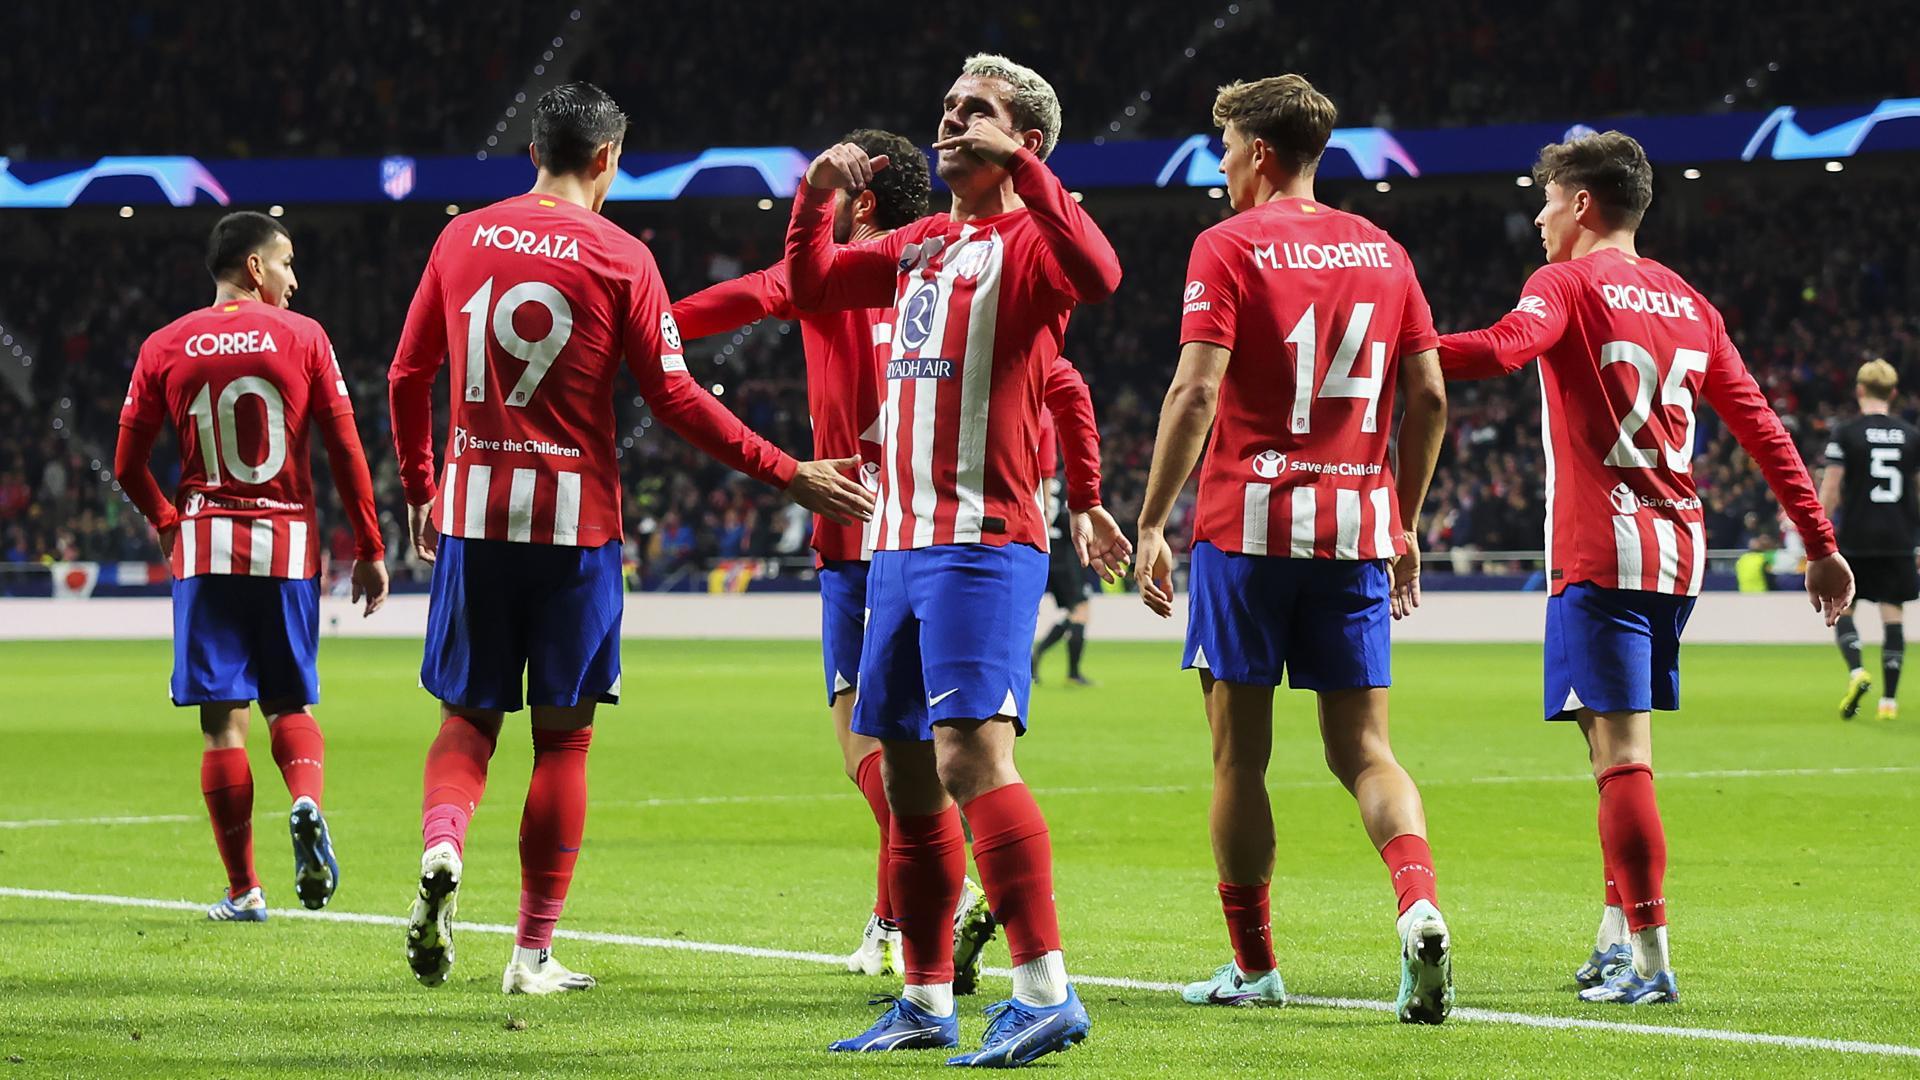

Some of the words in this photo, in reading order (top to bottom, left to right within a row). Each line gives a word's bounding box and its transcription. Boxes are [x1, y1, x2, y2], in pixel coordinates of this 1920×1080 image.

[472, 224, 580, 262] MORATA
[1253, 243, 1283, 270] M.
[1283, 242, 1392, 270] LLORENTE
[1602, 284, 1699, 321] RIQUELME
[185, 330, 278, 357] CORREA
[460, 275, 573, 407] 19
[922, 360, 950, 377] AIR
[1284, 302, 1386, 434] 14
[1600, 340, 1708, 474] 25
[188, 375, 287, 487] 10
[469, 436, 500, 451] Save
[503, 439, 522, 452] the
[523, 440, 580, 457] Children
[1870, 447, 1903, 503] 5
[1641, 494, 1673, 507] Save
